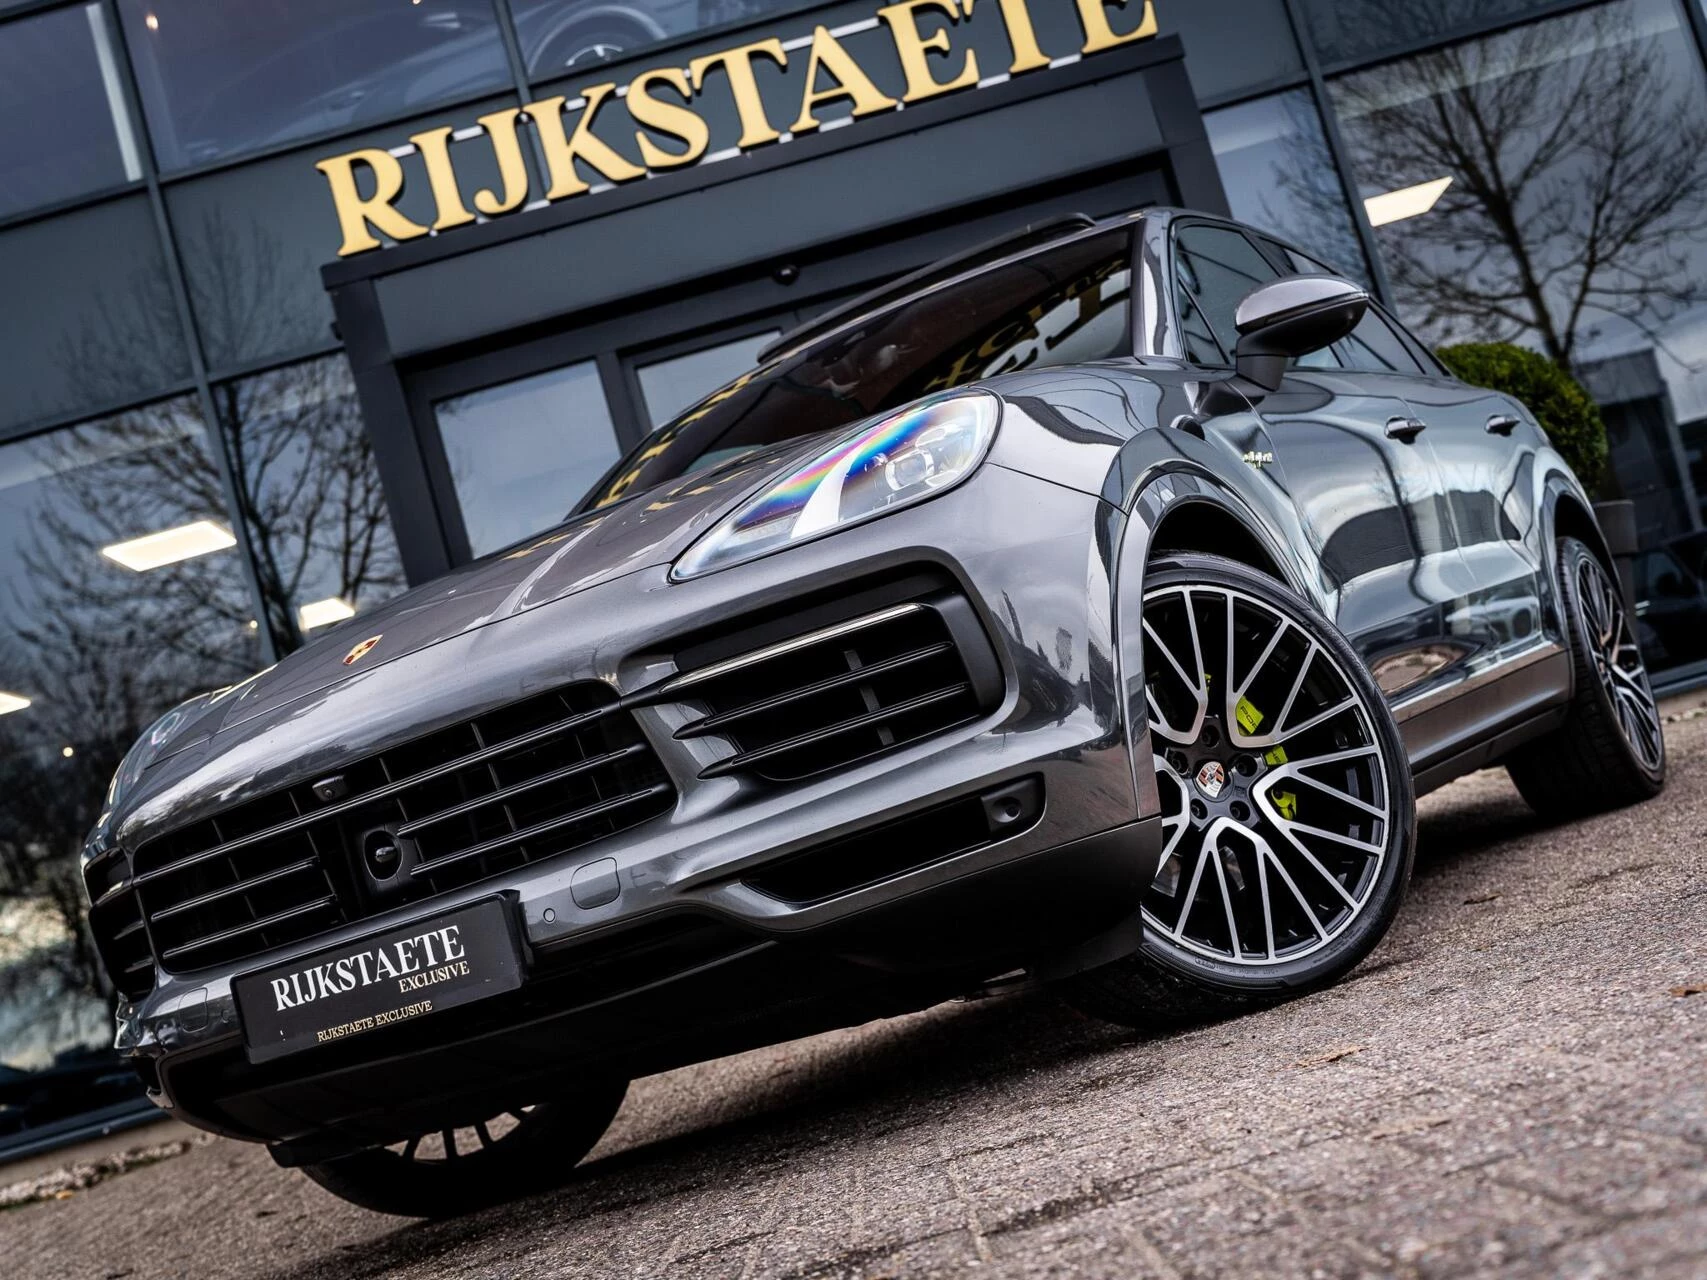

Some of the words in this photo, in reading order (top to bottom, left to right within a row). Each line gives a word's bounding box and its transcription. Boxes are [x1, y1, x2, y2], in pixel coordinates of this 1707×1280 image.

[315, 0, 1159, 257] RIJKSTAETE
[270, 924, 465, 1012] RIJKSTAETE
[398, 960, 470, 994] EXCLUSIVE
[316, 1016, 375, 1043] RIJKSTAETE
[375, 1000, 433, 1026] EXCLUSIVE
